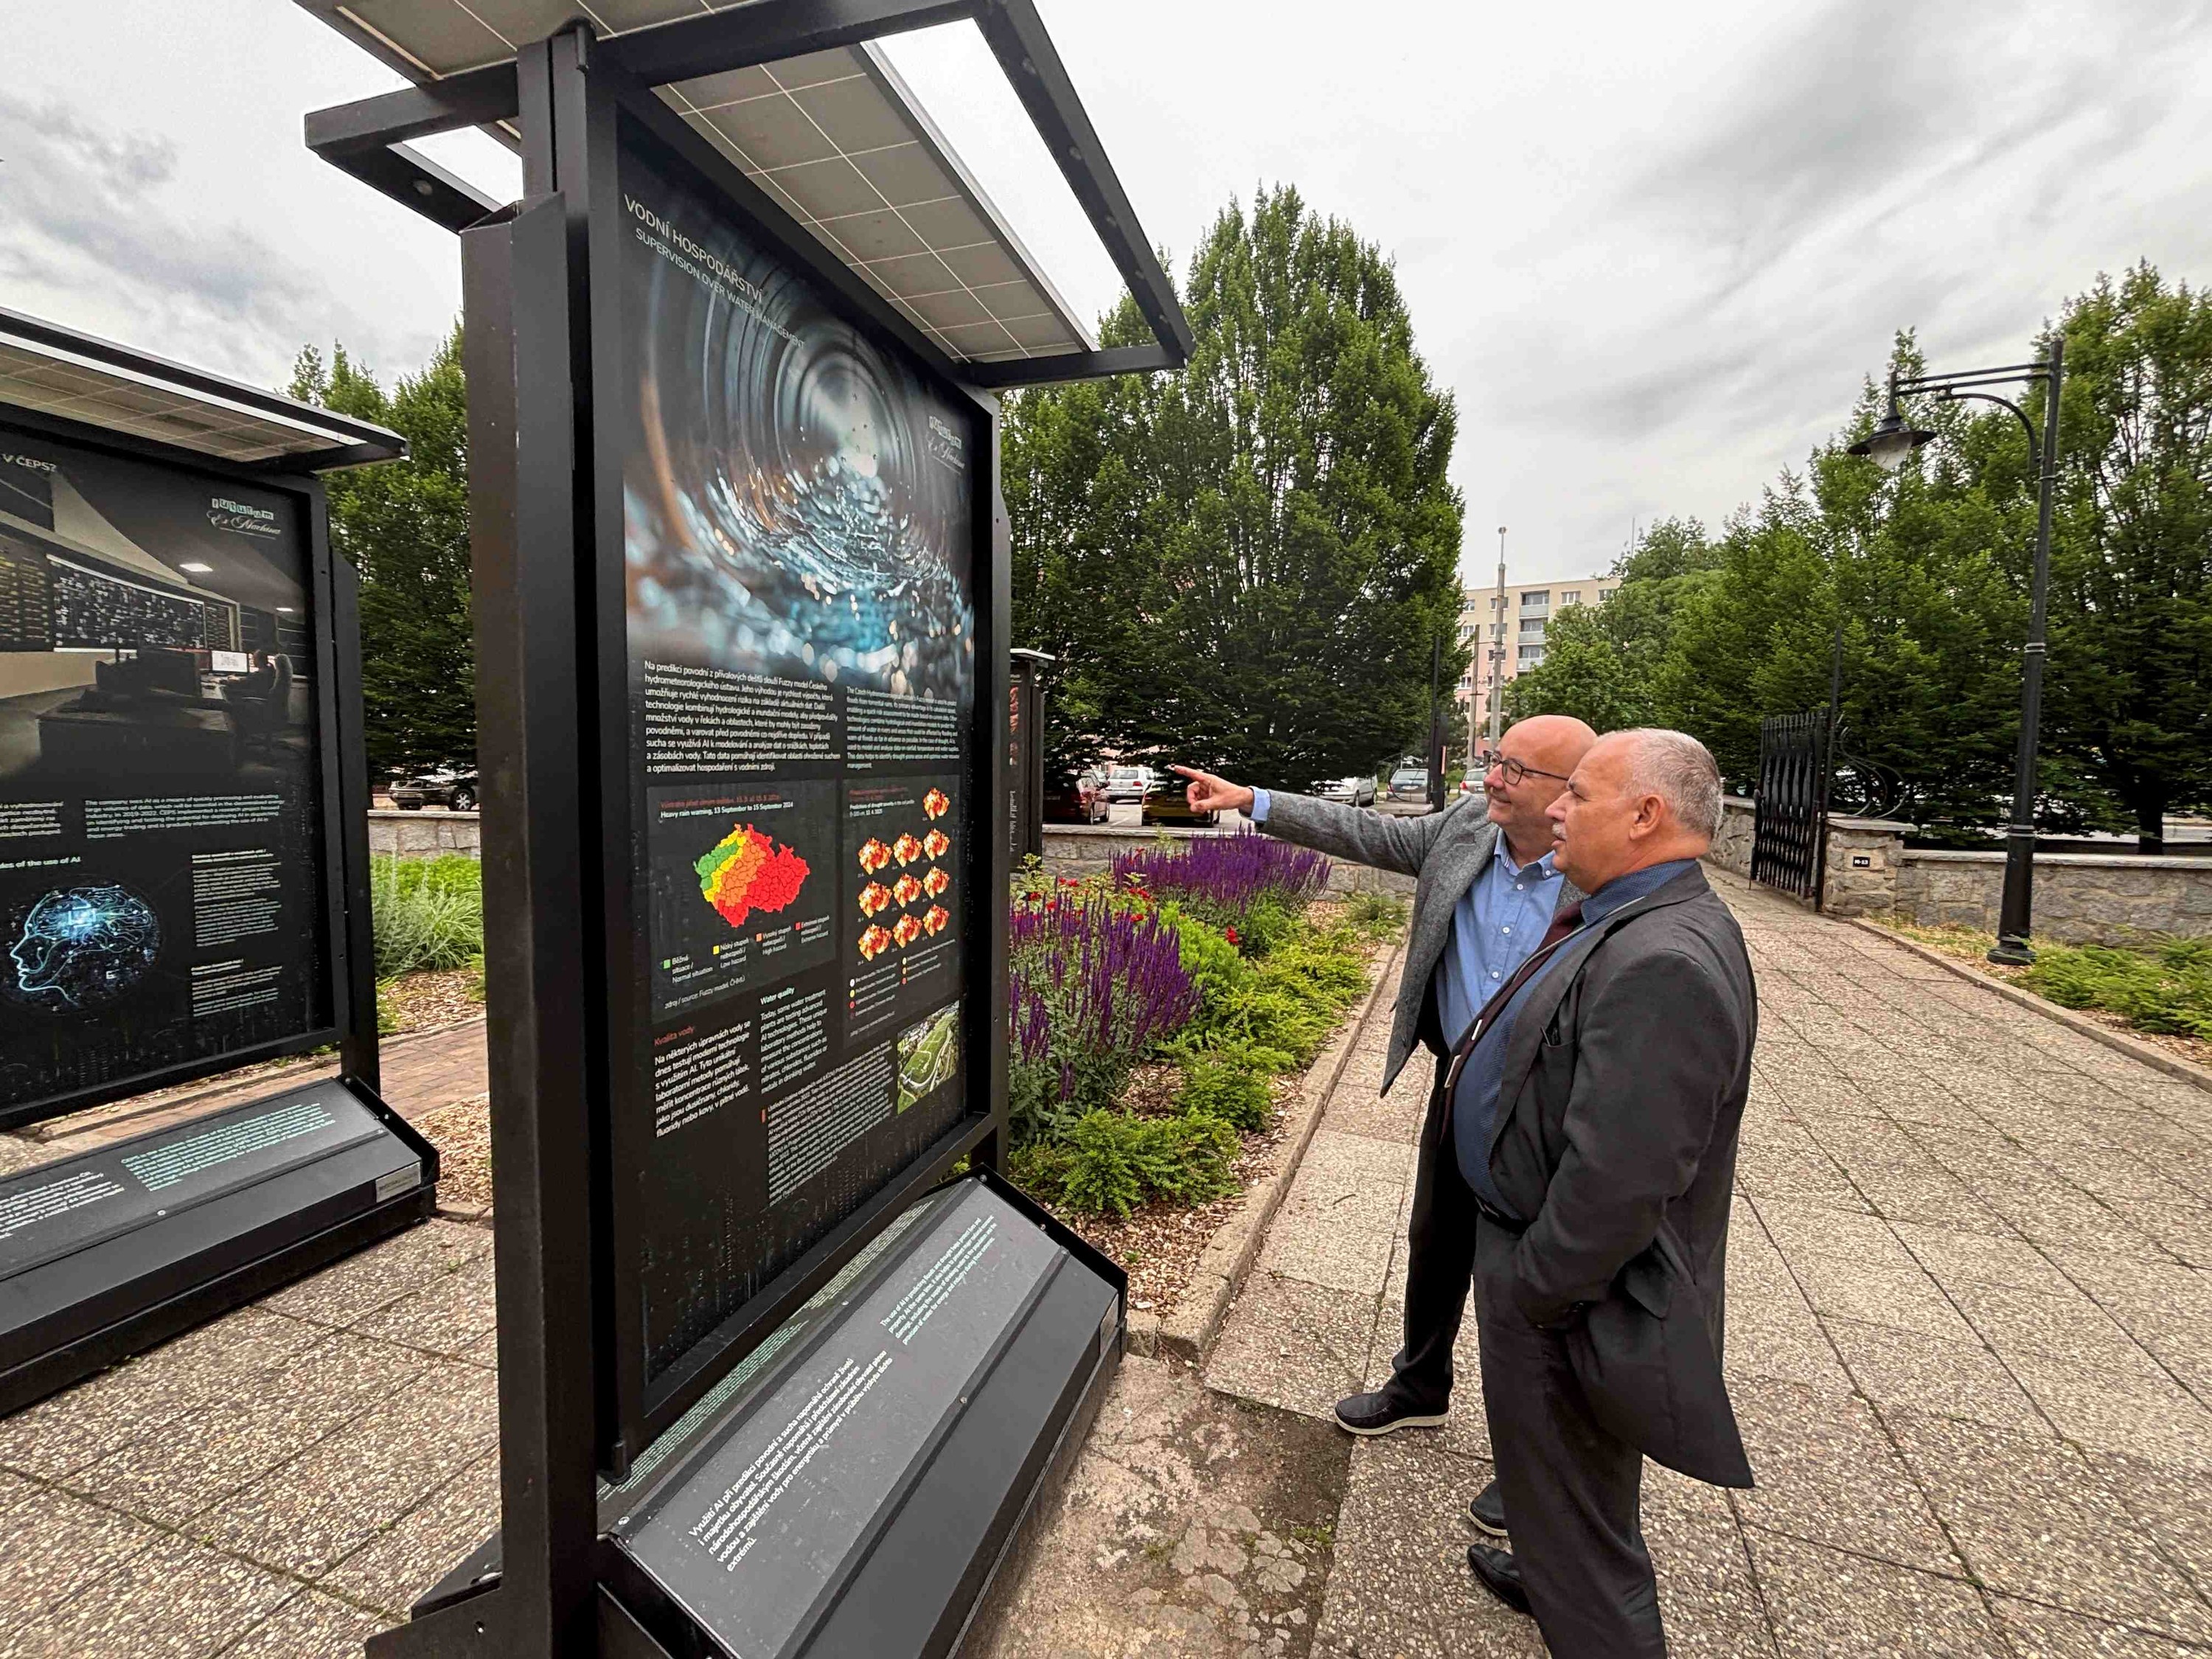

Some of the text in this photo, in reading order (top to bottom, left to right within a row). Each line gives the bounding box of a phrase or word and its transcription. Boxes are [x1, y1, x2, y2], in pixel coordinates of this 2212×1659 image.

[625, 193, 763, 302] VODNÍ HOSPODÁŘSTVÍ
[636, 227, 805, 349] SUPERVISION OVER WATER MANAGEMENT
[1, 453, 58, 473] V ČEPS?
[644, 659, 713, 678] Na predikci povodní z
[644, 674, 720, 690] hydrometeorologického
[644, 688, 699, 700] umožňuje rychlé
[644, 699, 684, 712] technologie
[644, 713, 677, 723] množství
[677, 714, 694, 725] vody
[645, 737, 709, 748] sucha se využívá AI
[652, 751, 684, 759] zásobách
[702, 751, 716, 759] Tato
[716, 751, 730, 759] data
[652, 762, 696, 773] optimalizovat
[660, 810, 678, 818] Heavy
[713, 806, 720, 814] 13
[720, 805, 747, 813] September
[672, 972, 691, 984] Normal
[759, 987, 795, 1005] Water quality
[776, 1004, 790, 1015] some
[790, 998, 804, 1008] water
[804, 988, 826, 1003] treatment
[759, 998, 823, 1033] plants are testing advanced
[654, 1026, 695, 1046] Kvalita vody
[654, 1020, 751, 1065] Na některých úpravnách vody se
[759, 1032, 767, 1043] AI
[654, 1032, 750, 1077] dnes testují moderní technologie
[655, 1082, 660, 1090] s
[660, 1069, 688, 1087] využitím
[698, 1059, 712, 1070] Tyto
[655, 1054, 740, 1102] laboratorní metody pomáhají
[655, 1099, 674, 1114] měřit
[674, 1082, 712, 1105] koncentrace
[655, 1113, 670, 1128] jako
[669, 1107, 684, 1121] jsou
[681, 1111, 698, 1125] nebo
[687, 1506, 715, 1536] Využití
[713, 1499, 724, 1512] AI
[721, 1488, 734, 1503] při
[731, 1463, 757, 1493] predikci
[754, 1438, 779, 1468] povodní
[780, 1419, 798, 1438] sucha
[795, 1391, 823, 1421] napomáhá
[820, 1371, 841, 1394] ochraně
[708, 1478, 774, 1555] národohospodářským
[793, 1432, 813, 1454] včetně
[810, 1409, 832, 1436] zajištění
[830, 1382, 857, 1414] zásobování
[854, 1363, 874, 1386] obyvatel
[716, 1537, 740, 1562] vodou
[738, 1530, 745, 1539] a
[742, 1499, 770, 1532] zajištění
[767, 1484, 784, 1503] vody
[781, 1473, 793, 1488] pro
[791, 1442, 823, 1475] energetiku
[821, 1414, 843, 1441] průmysl
[844, 1390, 864, 1414] průběhu
[861, 1371, 880, 1392] výskytu
[697, 1538, 705, 1546] i
[702, 1510, 731, 1542] majetku
[754, 1449, 785, 1482] Současně
[782, 1419, 811, 1453] napomáhá
